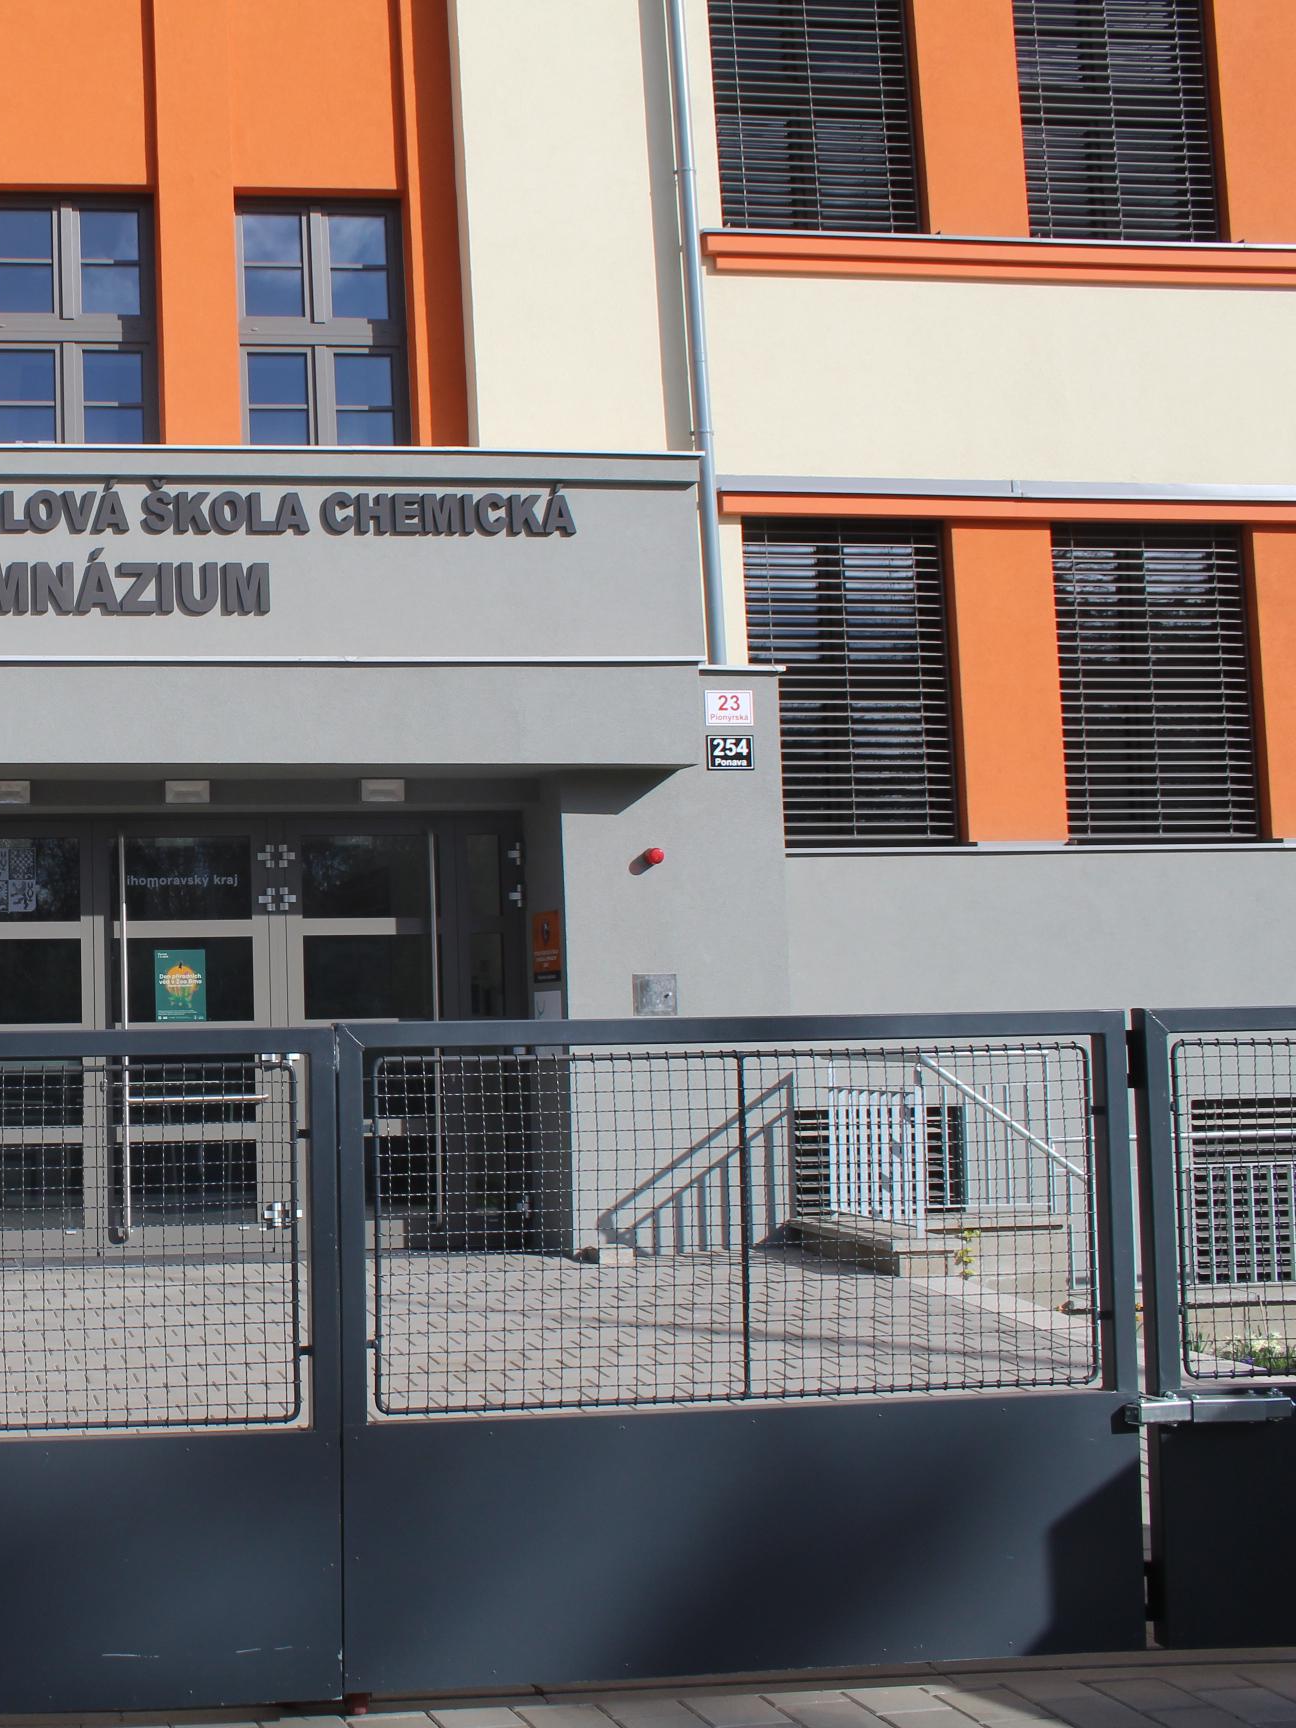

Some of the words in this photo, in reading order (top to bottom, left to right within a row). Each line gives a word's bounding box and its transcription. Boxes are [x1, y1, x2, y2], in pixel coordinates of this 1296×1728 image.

[140, 479, 310, 537] ŠKOLA
[319, 483, 577, 538] CHEMICKÁ
[718, 694, 741, 711] 23
[712, 738, 749, 756] 254
[714, 757, 747, 767] Ponava
[127, 874, 209, 888] ihomoravský
[213, 874, 238, 887] kraj
